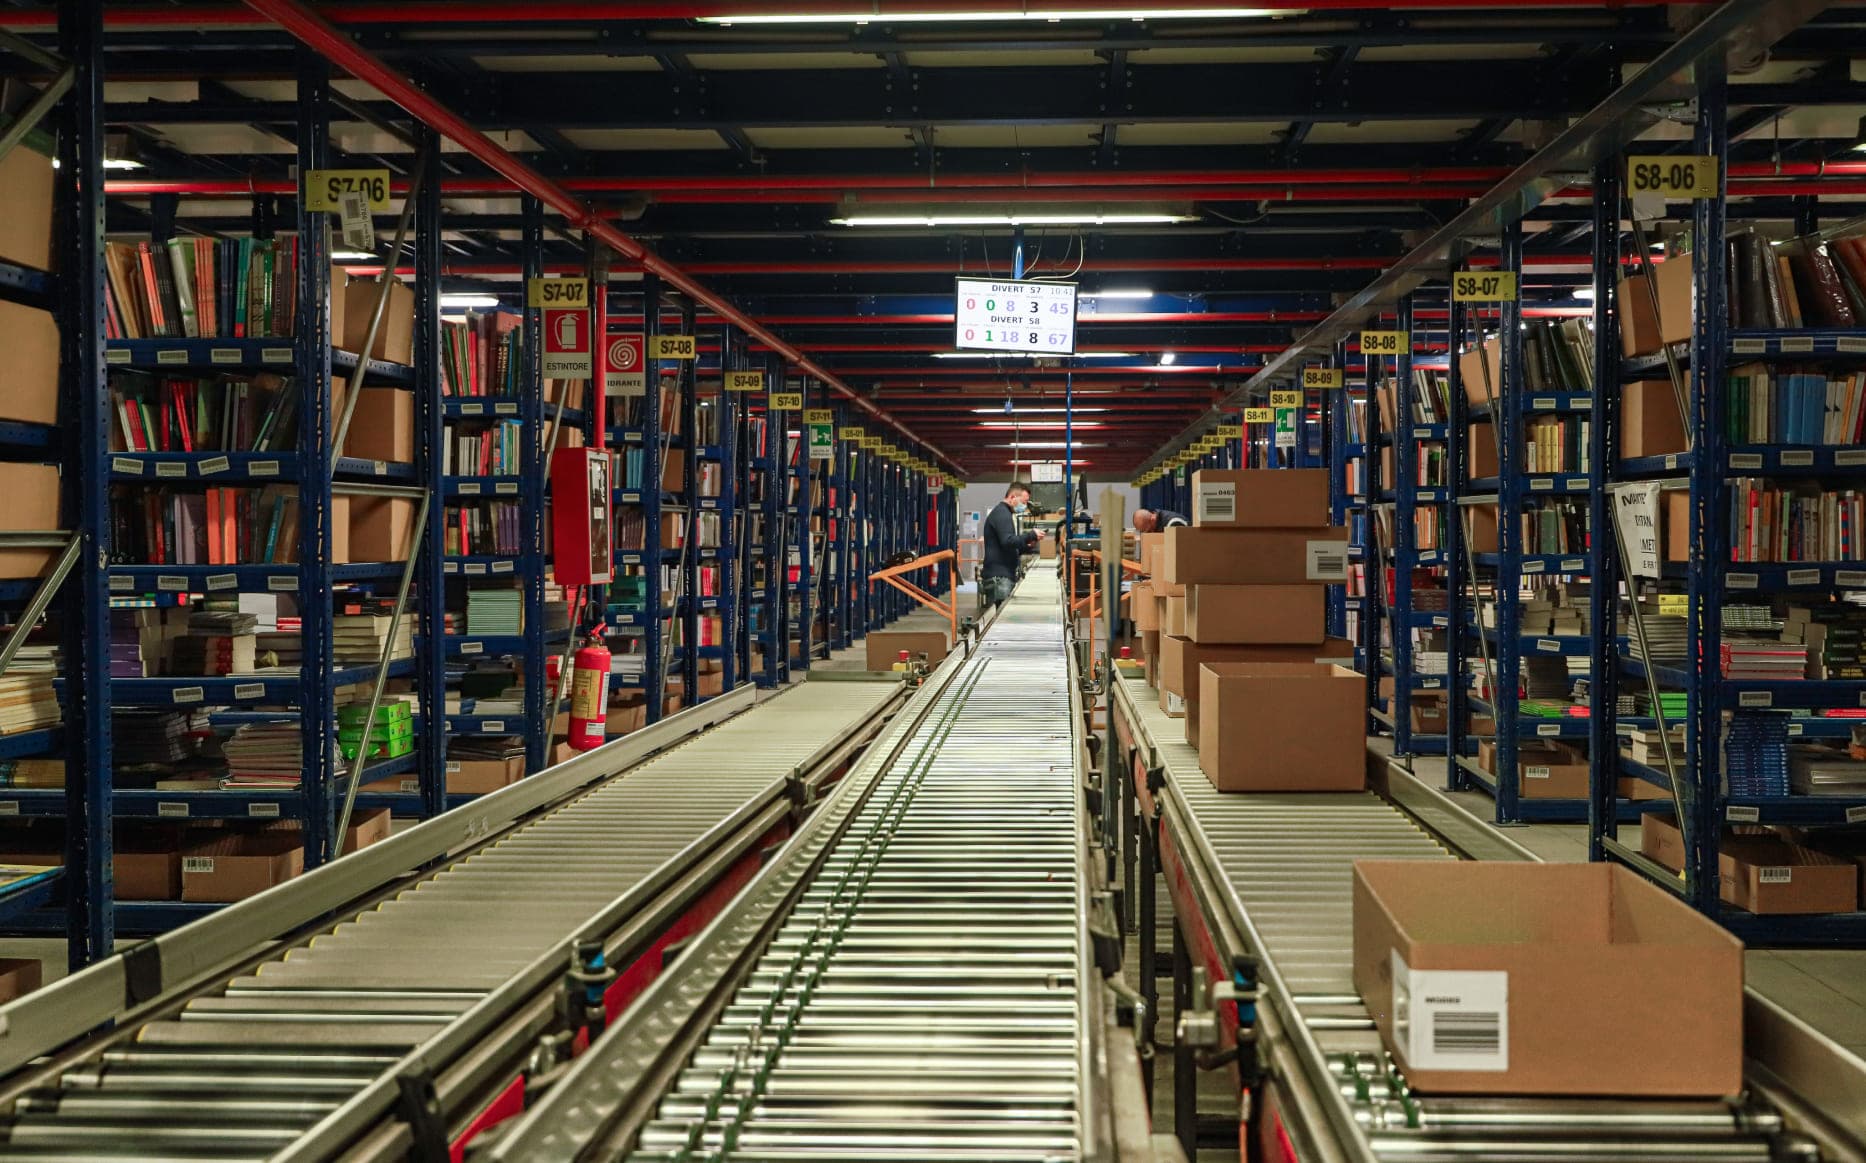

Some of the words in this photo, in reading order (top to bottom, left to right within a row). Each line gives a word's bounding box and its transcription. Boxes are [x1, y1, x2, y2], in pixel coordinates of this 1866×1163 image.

[1634, 164, 1695, 190] S8-06
[543, 283, 583, 300] S7-07
[1457, 277, 1499, 296] S8-07
[966, 299, 975, 310] 0
[986, 299, 995, 311] 0
[1006, 300, 1015, 312] 8
[1030, 302, 1039, 313] 3
[1049, 303, 1069, 314] 45
[991, 316, 1023, 324] DIVERT
[965, 329, 974, 340] 0
[985, 330, 993, 341] 1
[1000, 331, 1019, 343] 18
[1029, 333, 1038, 343] 8
[1049, 333, 1068, 345] 67
[660, 340, 692, 354] S7-08
[1364, 336, 1396, 349] S8-08
[546, 363, 588, 371] ESTINTORE
[734, 376, 759, 386] S7-09
[1306, 373, 1332, 383] S8-09
[777, 397, 799, 406] S7-10
[1272, 394, 1295, 404] S8-10
[810, 412, 830, 420] S7-11
[1247, 411, 1267, 420] S8-11
